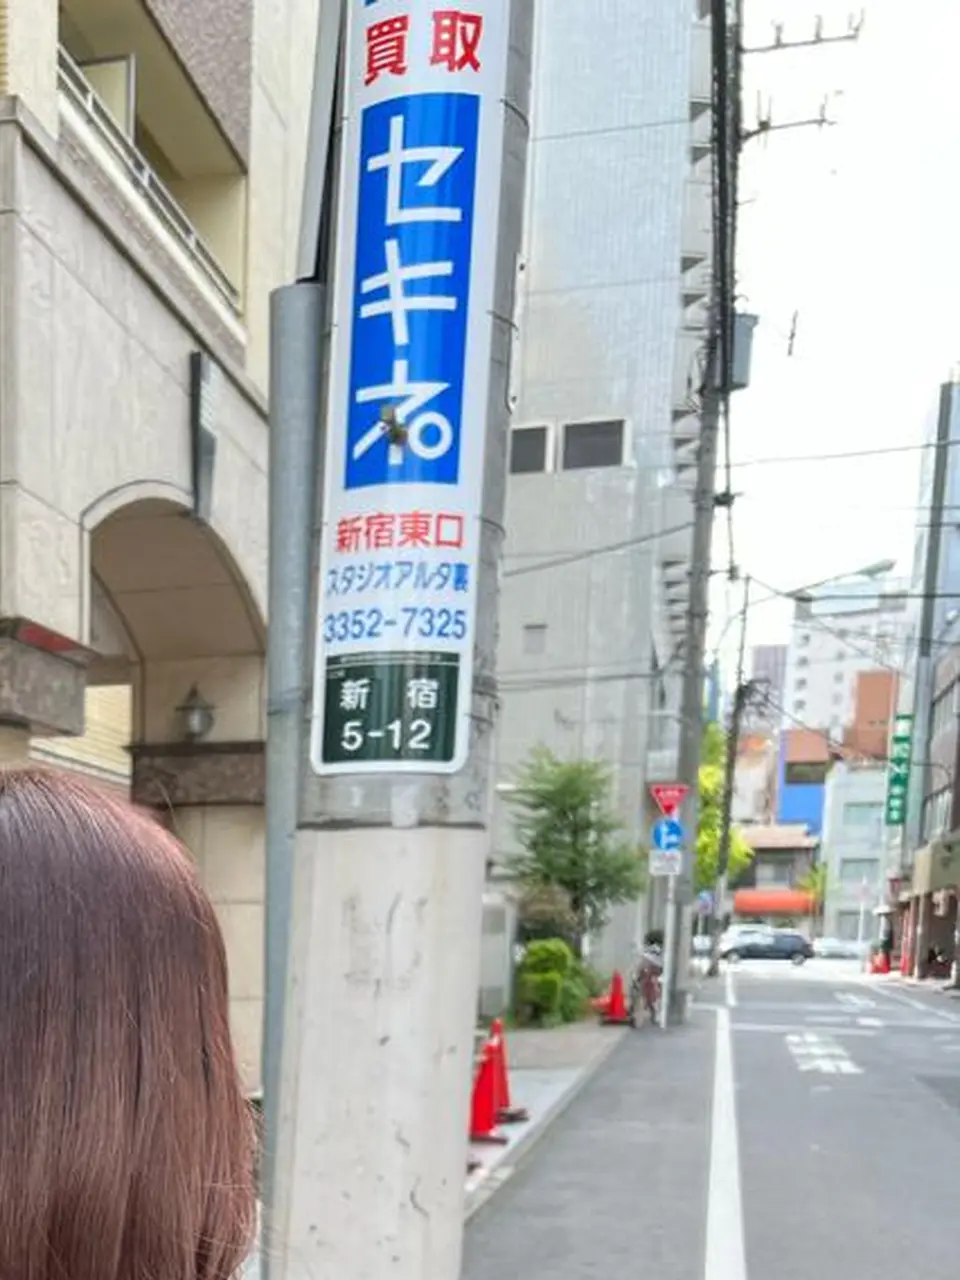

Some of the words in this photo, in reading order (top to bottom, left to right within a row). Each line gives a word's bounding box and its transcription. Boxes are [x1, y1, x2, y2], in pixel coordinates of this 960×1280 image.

[364, 10, 483, 86] 買取
[353, 115, 464, 465] セキネ
[336, 513, 464, 552] 新宿東口
[324, 608, 467, 643] 3352-7325
[340, 678, 438, 711] 新宿
[341, 719, 432, 751] 5-12
